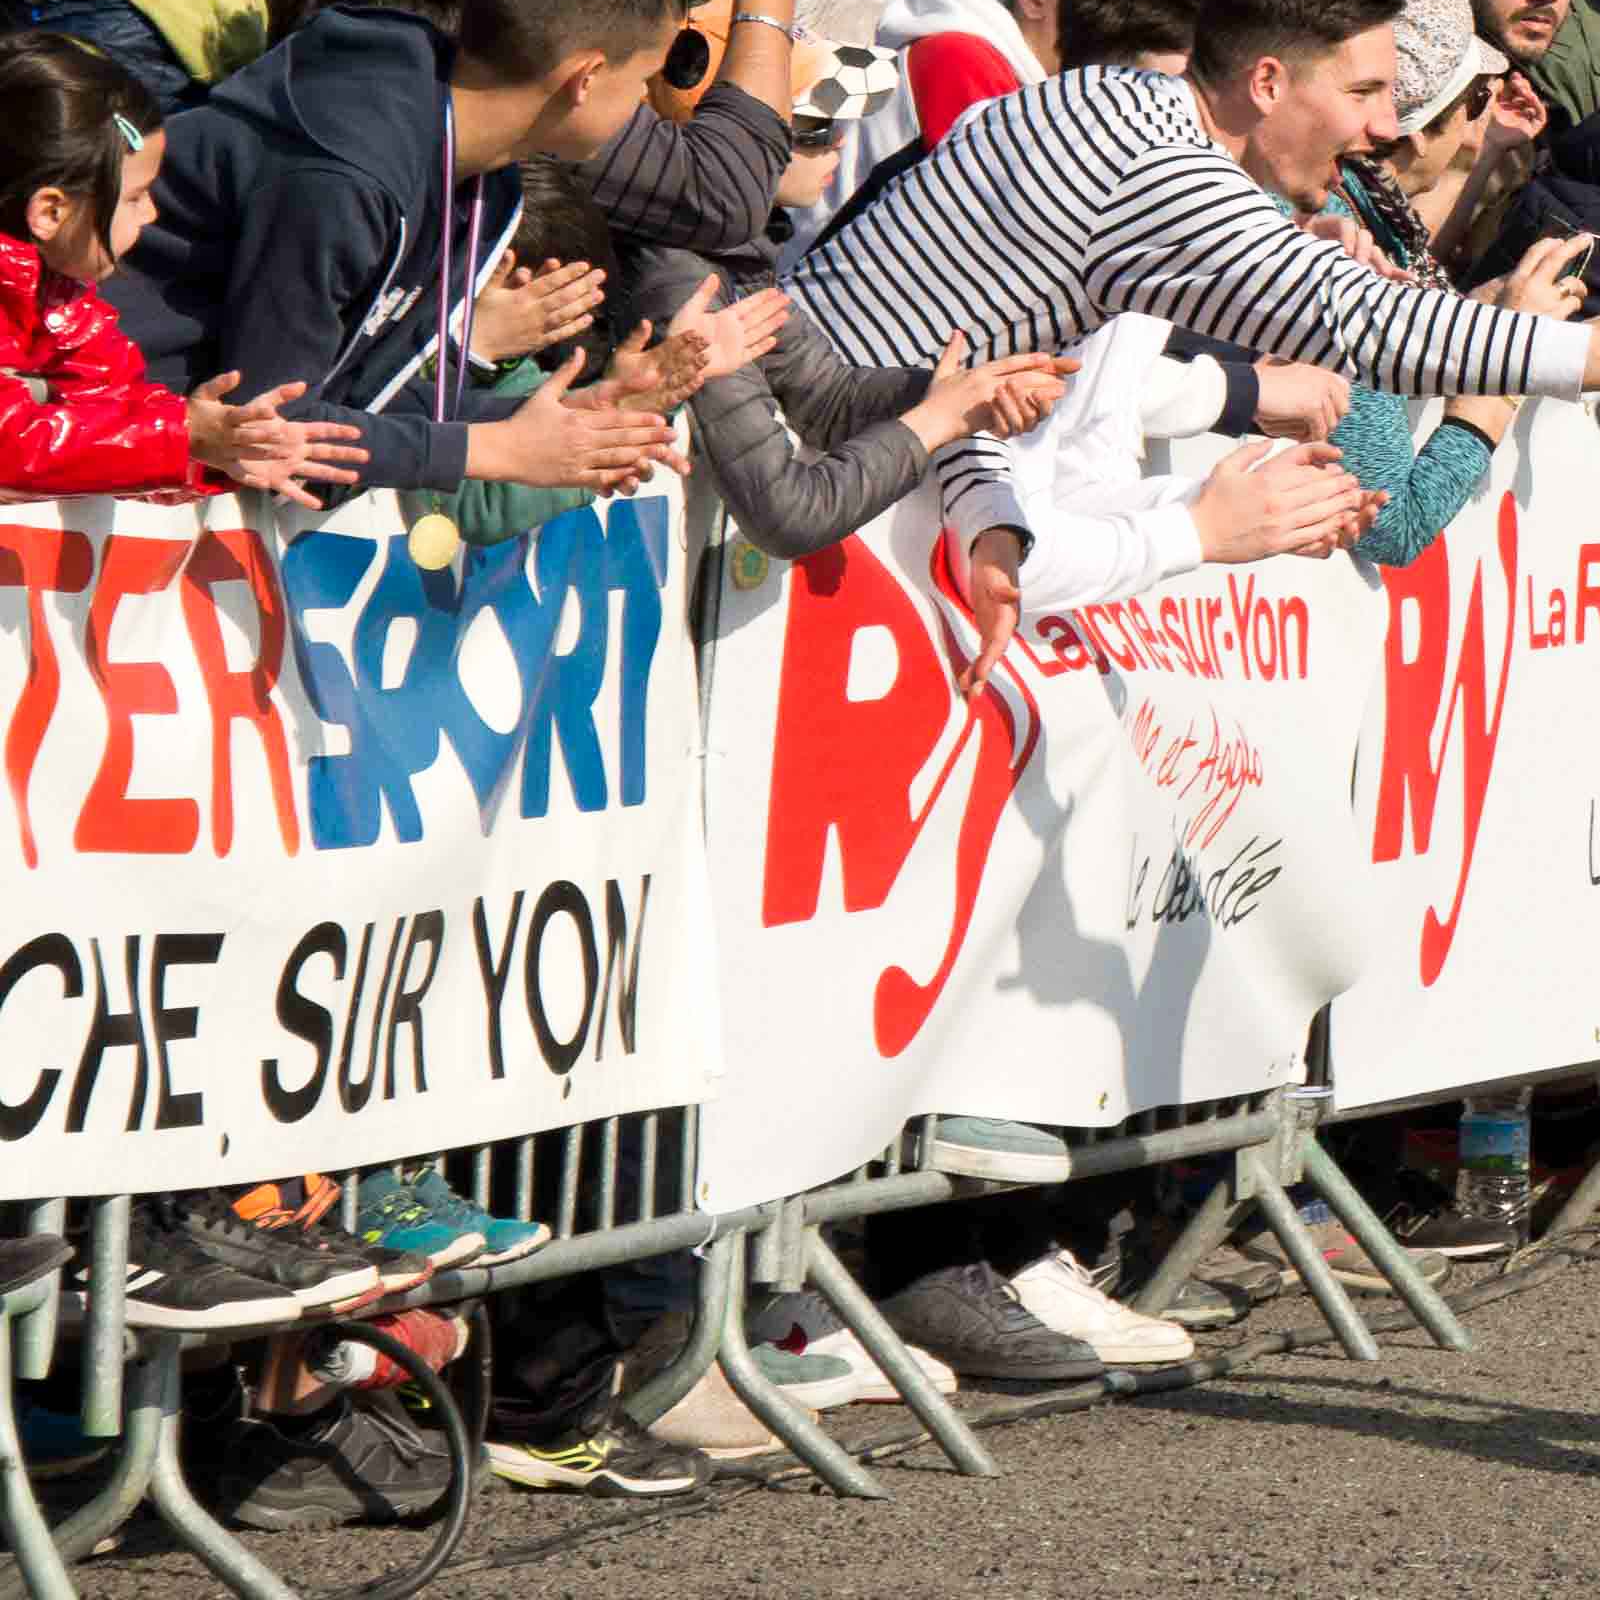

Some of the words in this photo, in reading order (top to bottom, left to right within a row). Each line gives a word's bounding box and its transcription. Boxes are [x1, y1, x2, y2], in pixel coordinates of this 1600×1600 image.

[1527, 574, 1567, 650] La
[261, 908, 446, 1124] SUR
[472, 874, 653, 1079] YON
